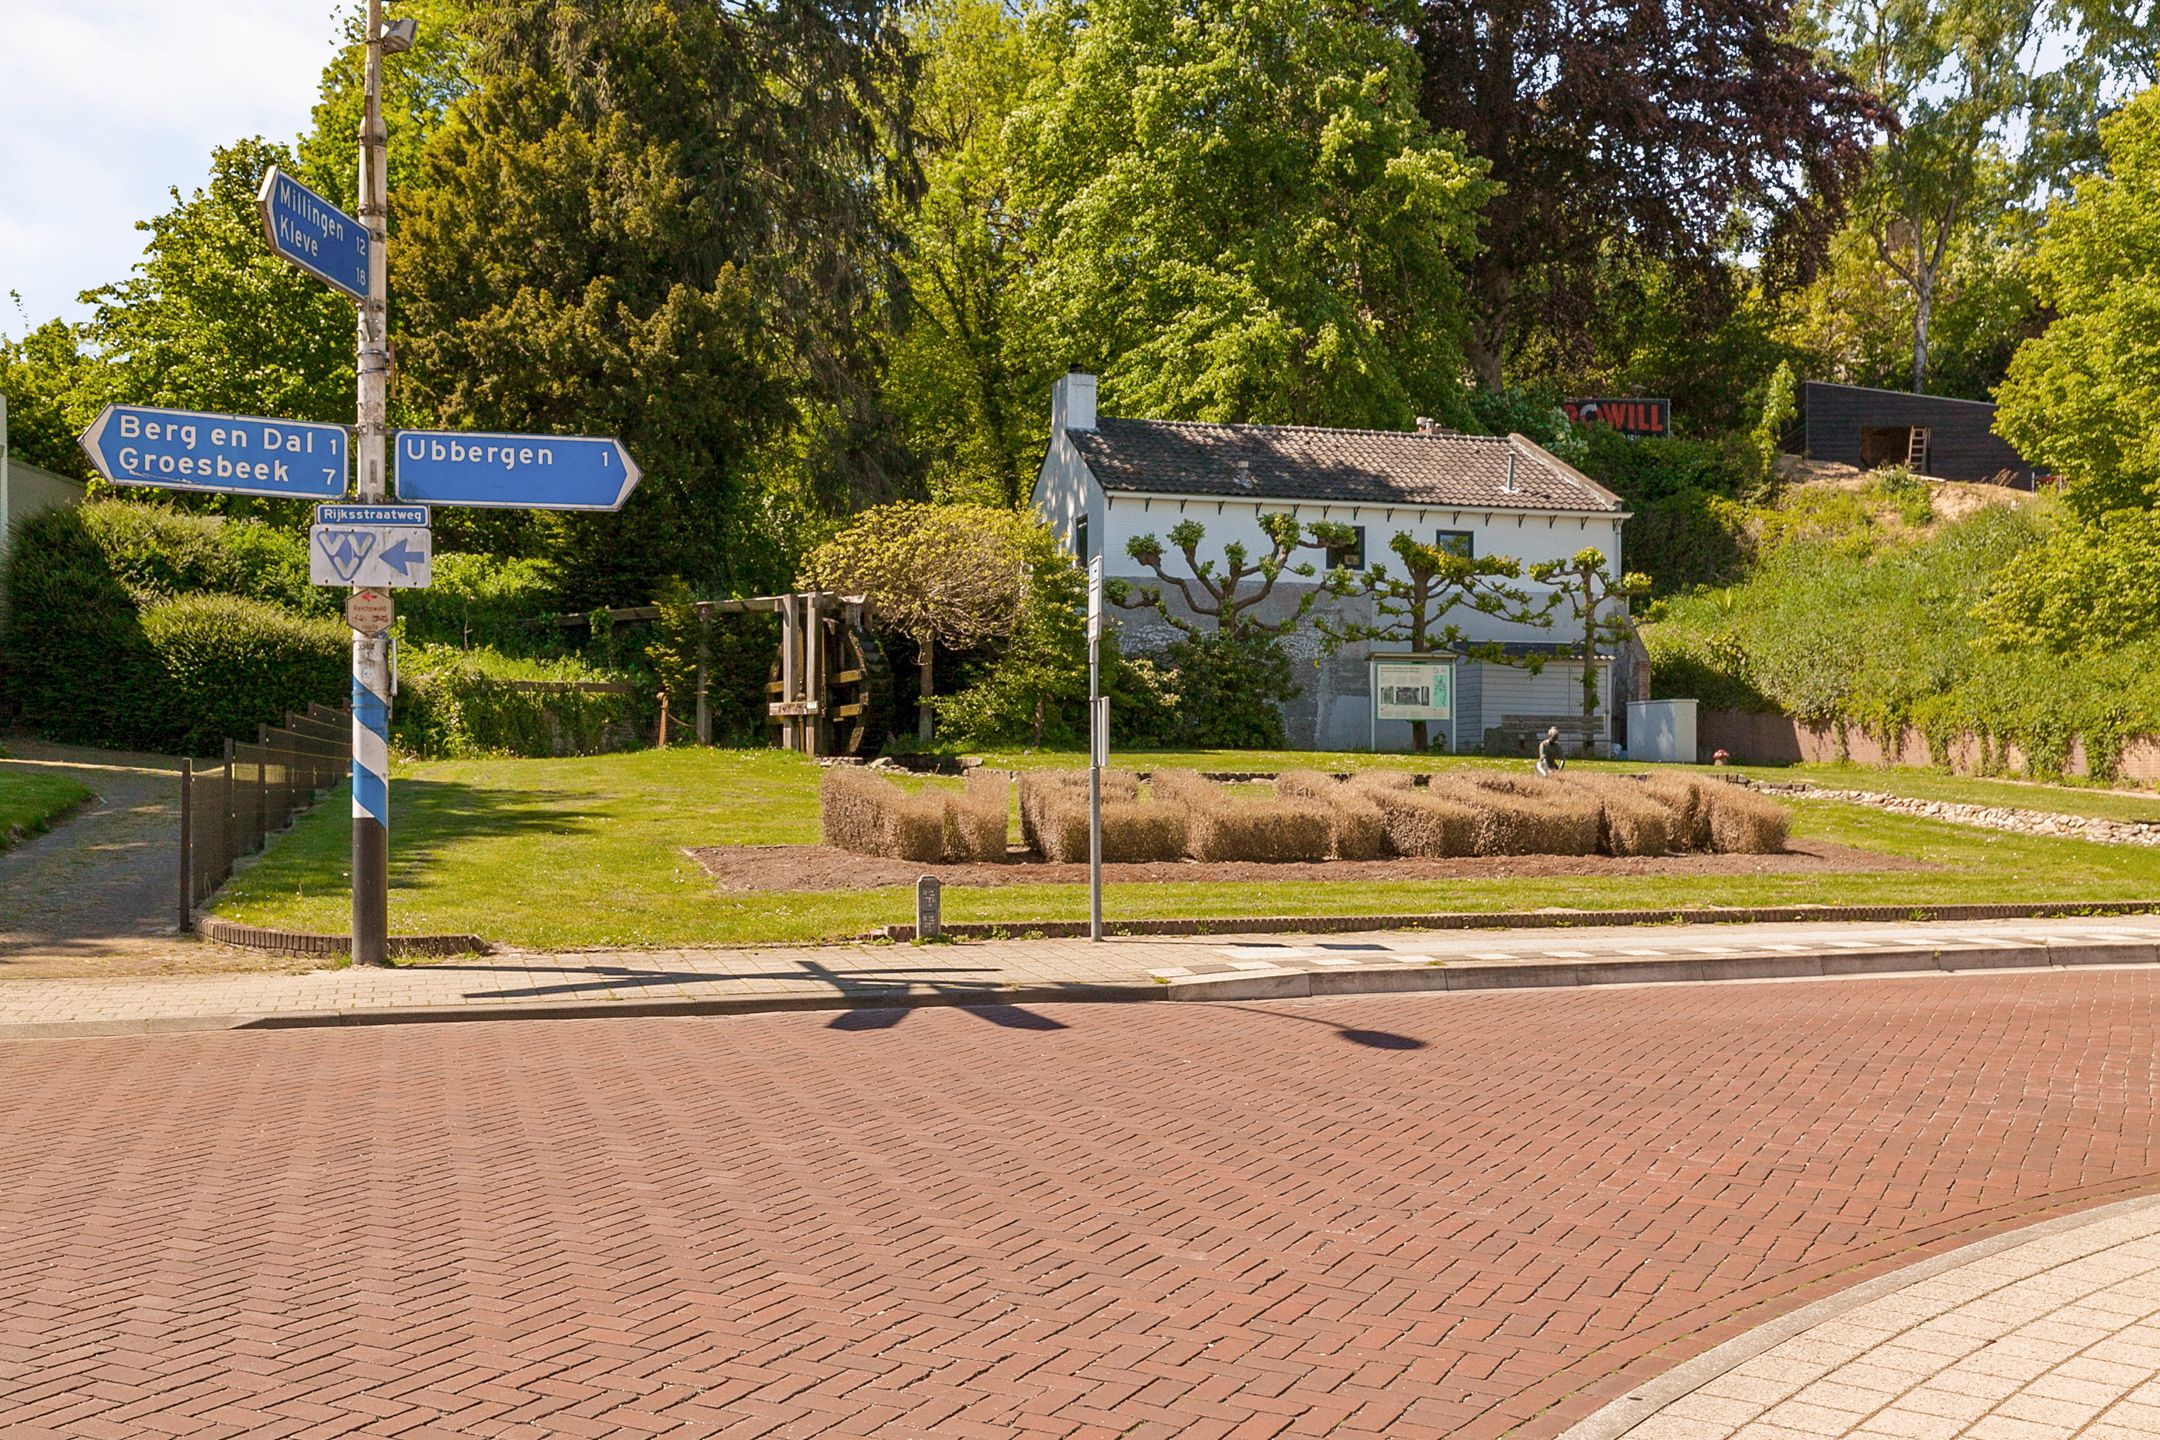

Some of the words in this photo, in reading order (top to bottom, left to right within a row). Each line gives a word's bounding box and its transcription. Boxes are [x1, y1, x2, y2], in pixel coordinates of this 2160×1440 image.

[280, 181, 344, 243] Millingen
[356, 236, 366, 257] 12
[280, 214, 318, 258] Kleve
[356, 266, 366, 287] 18
[119, 414, 197, 450] Berg
[211, 427, 247, 448] en
[263, 427, 313, 453] Dal
[330, 439, 337, 456] 1
[406, 438, 554, 471] Ubbergen
[602, 451, 609, 467] 1
[118, 446, 289, 483] Groesbeek
[321, 468, 336, 485] 7
[324, 508, 422, 522] Rijksstraatweg
[353, 604, 387, 612] Reichswald
